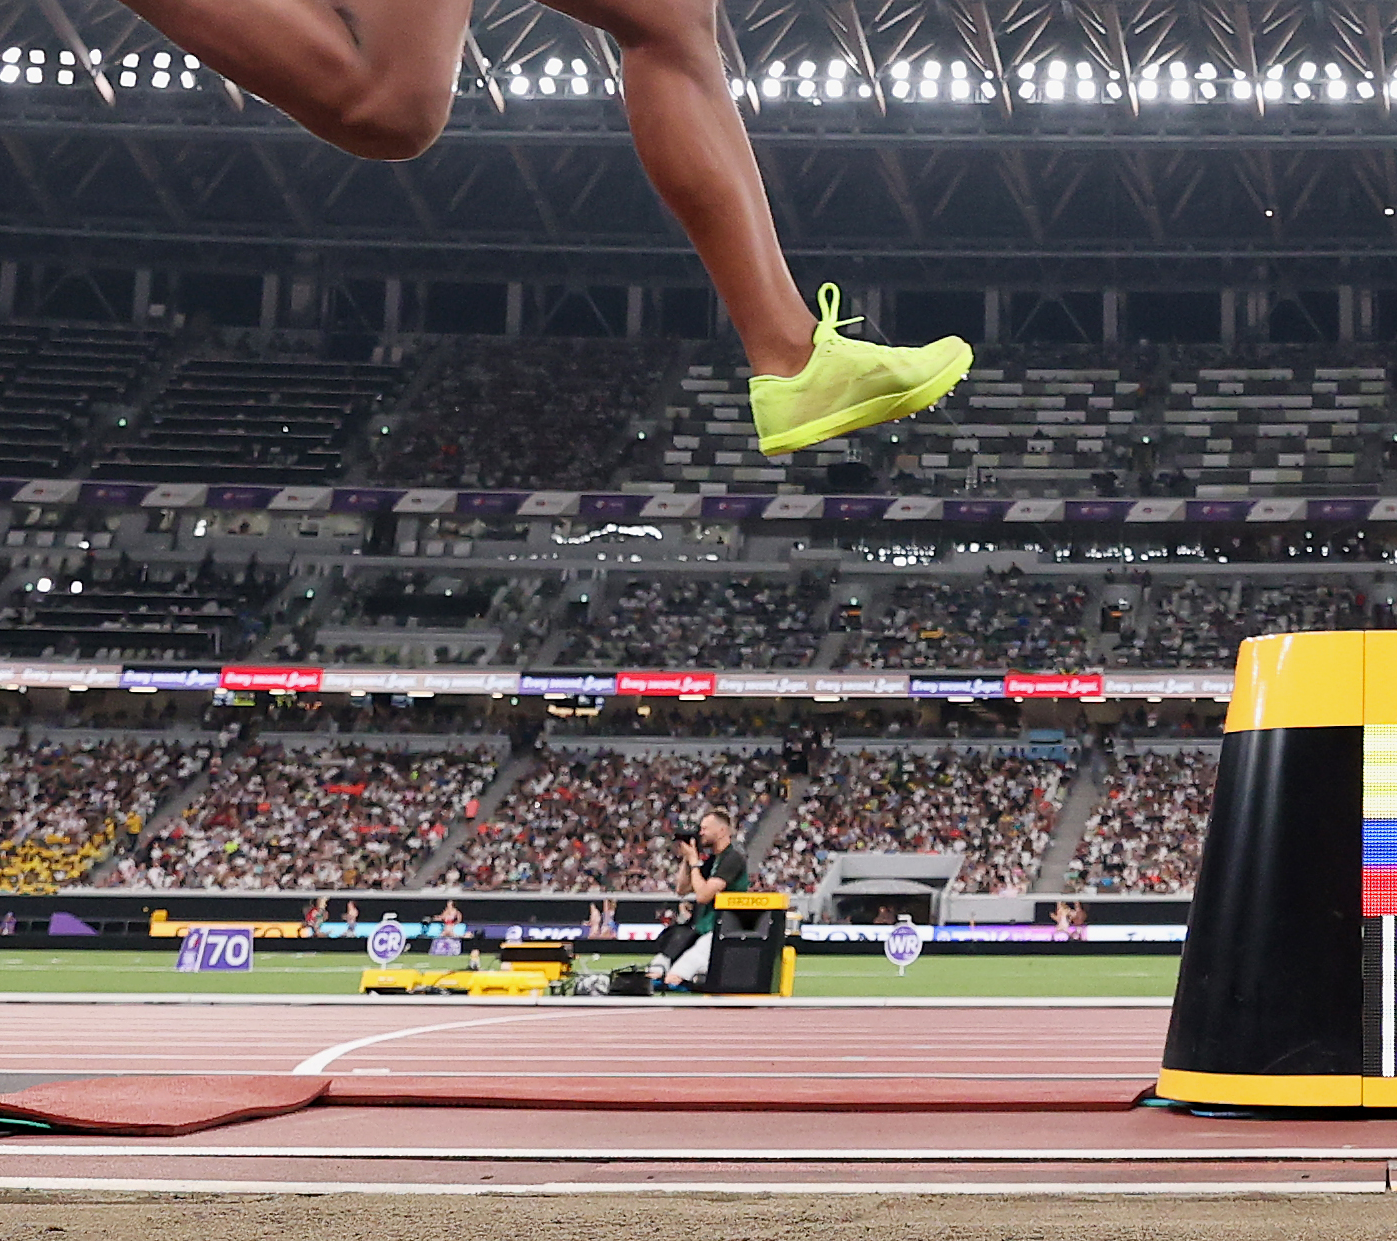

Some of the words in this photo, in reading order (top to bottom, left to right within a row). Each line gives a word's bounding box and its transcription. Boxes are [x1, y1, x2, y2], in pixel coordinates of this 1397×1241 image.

[207, 934, 250, 967] 70
[374, 932, 401, 952] CR
[889, 934, 918, 954] WR
